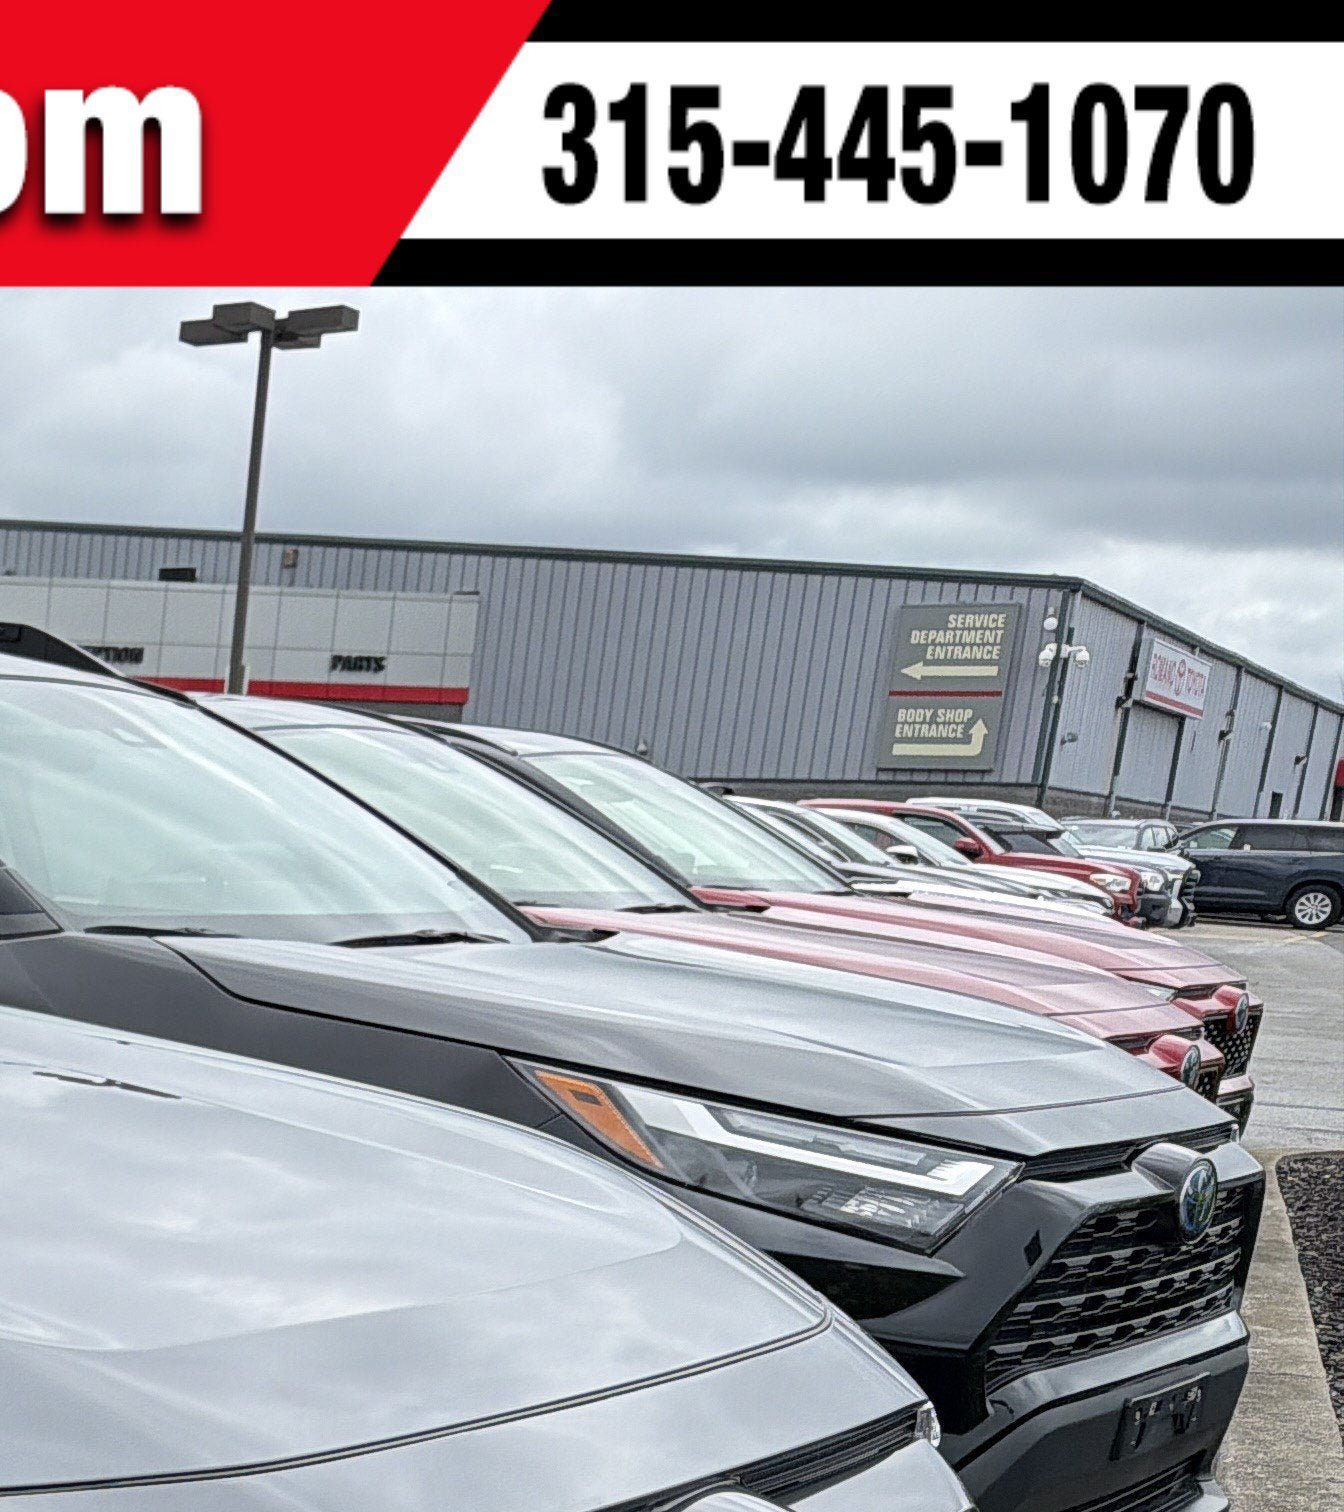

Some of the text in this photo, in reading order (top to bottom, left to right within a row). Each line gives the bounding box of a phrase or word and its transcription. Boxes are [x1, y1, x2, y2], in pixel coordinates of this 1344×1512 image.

[948, 613, 1007, 628] SERVICE
[910, 629, 1004, 645] DEPARTMENT
[926, 645, 1001, 660] ENTRANCE
[330, 654, 387, 673] PARTS
[897, 708, 973, 722] BODY SHOP
[895, 723, 965, 738] ENTRANCE
